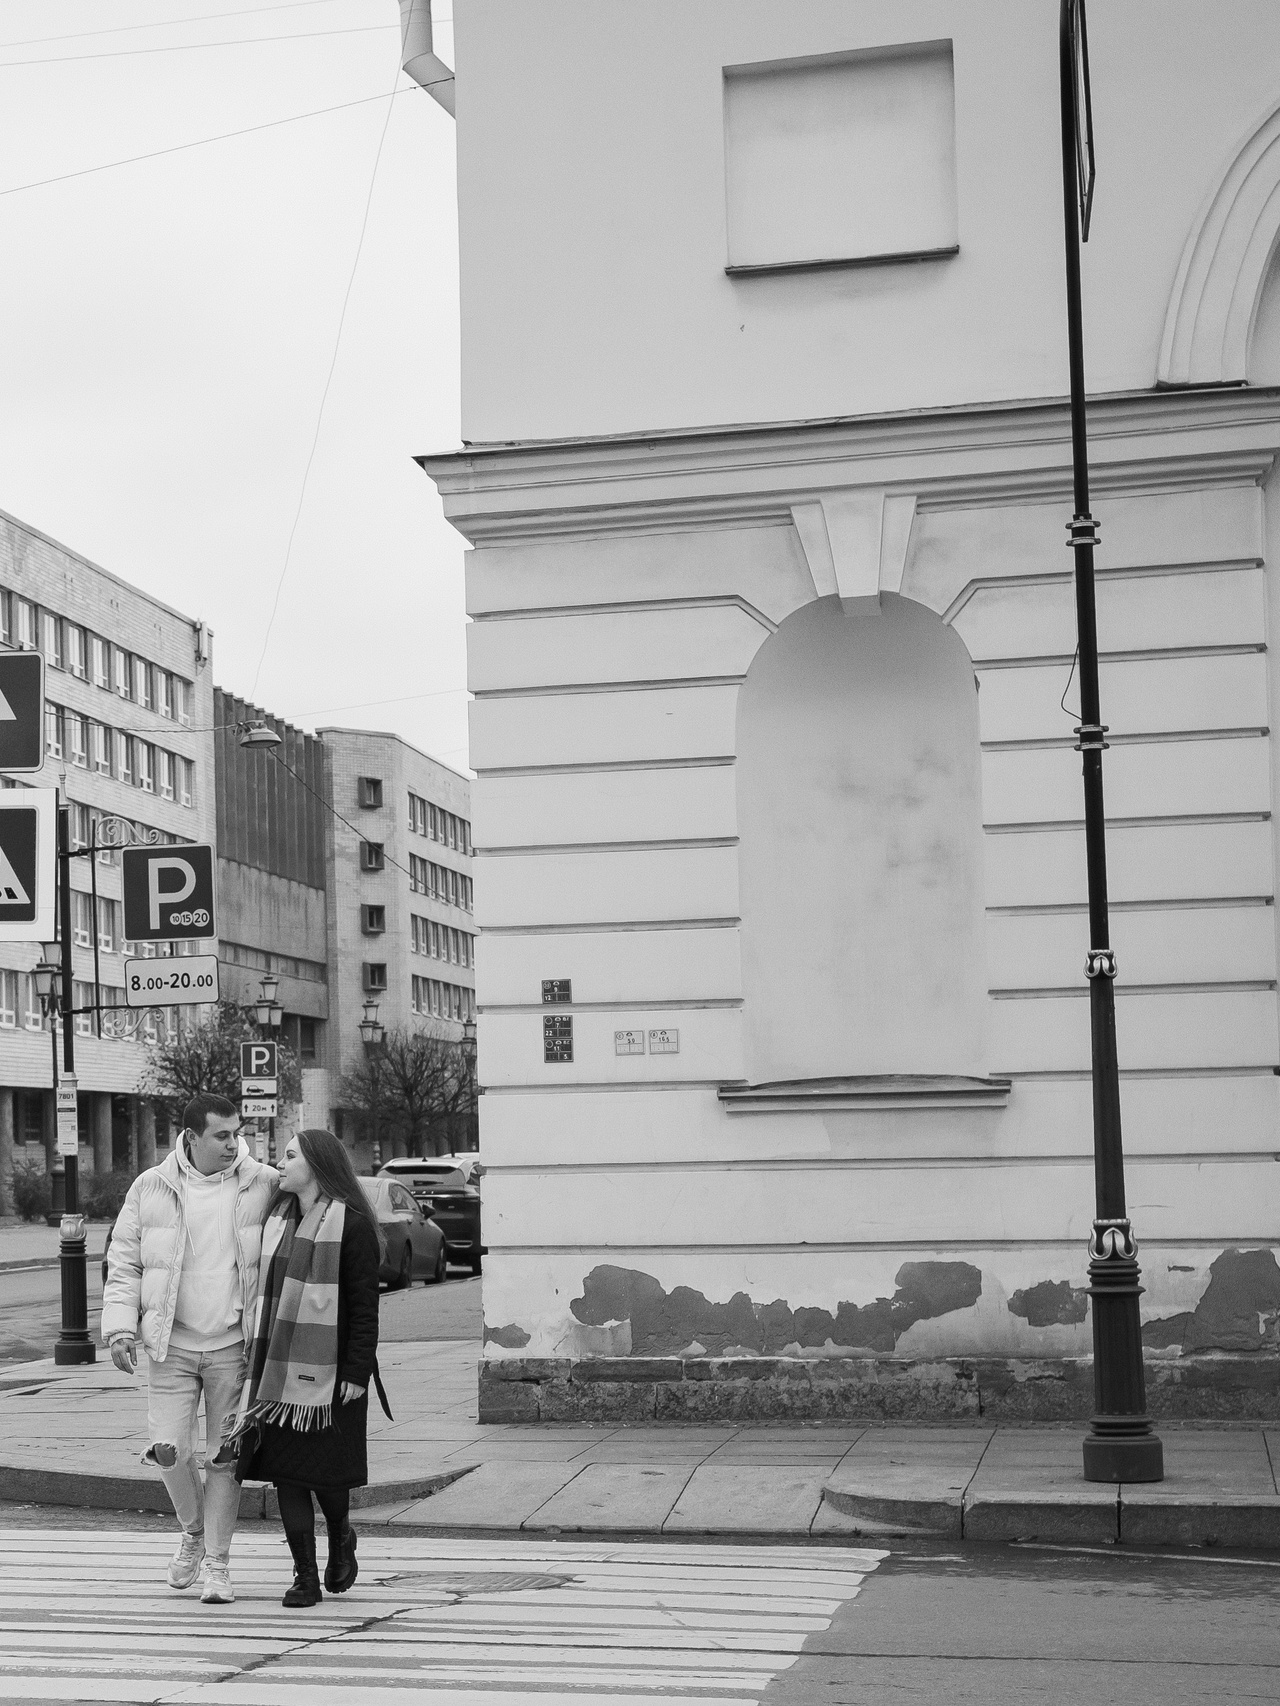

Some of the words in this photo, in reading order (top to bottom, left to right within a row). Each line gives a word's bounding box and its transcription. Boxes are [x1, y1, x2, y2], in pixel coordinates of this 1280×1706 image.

[148, 857, 197, 930] P
[172, 915, 180, 923] 10
[181, 913, 191, 922] 15
[194, 912, 208, 923] 20
[131, 972, 213, 991] 8.00-20.00
[251, 1046, 270, 1074] P
